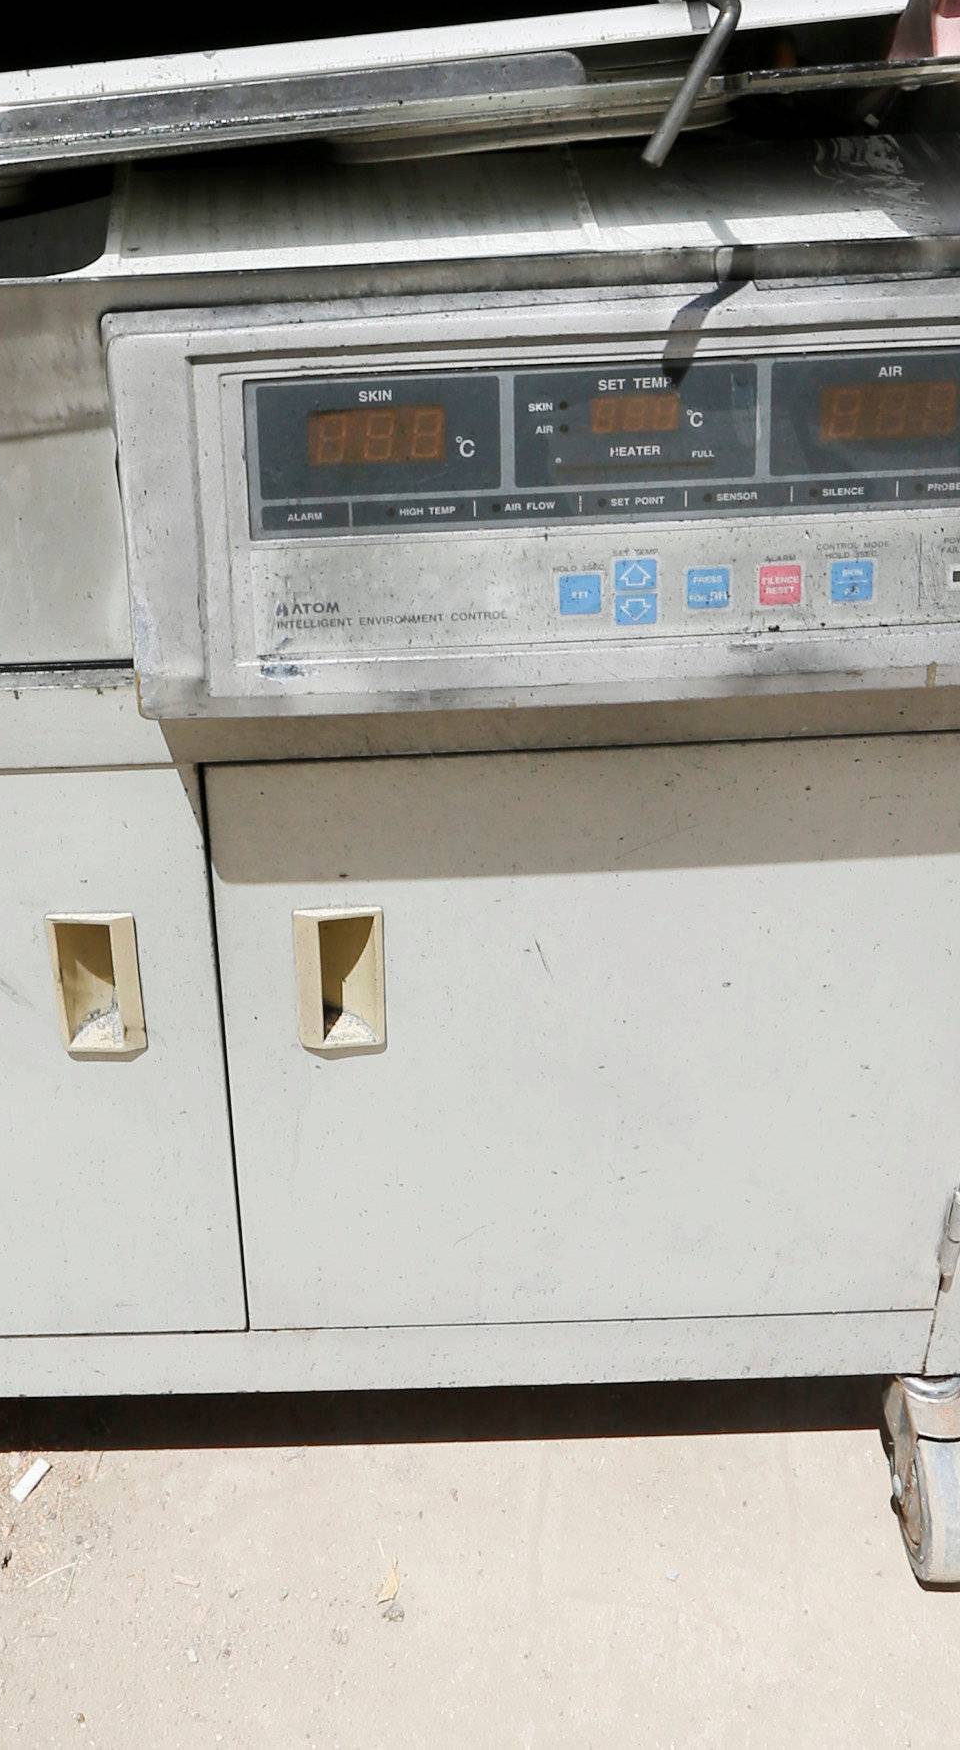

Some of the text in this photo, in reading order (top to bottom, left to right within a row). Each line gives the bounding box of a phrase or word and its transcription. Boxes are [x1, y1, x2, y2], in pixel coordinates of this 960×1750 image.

[878, 366, 902, 378] AIR
[598, 377, 672, 391] SET TEMP
[358, 390, 393, 403] SKIN
[528, 402, 553, 412] SKIN
[535, 424, 554, 435] AIR
[609, 445, 661, 458] HEATER
[691, 450, 715, 458] FULL
[716, 492, 758, 502] SENSOR
[822, 486, 865, 497] SILENCE
[504, 501, 555, 512] AIR FLOW
[610, 495, 665, 507] SET POINT
[287, 512, 323, 522] ALARM
[399, 505, 456, 517] HIGH TEMP
[291, 602, 341, 616] ATOM
[276, 610, 508, 630] INTELLIGENT ENVIRONMENT CONTROL
